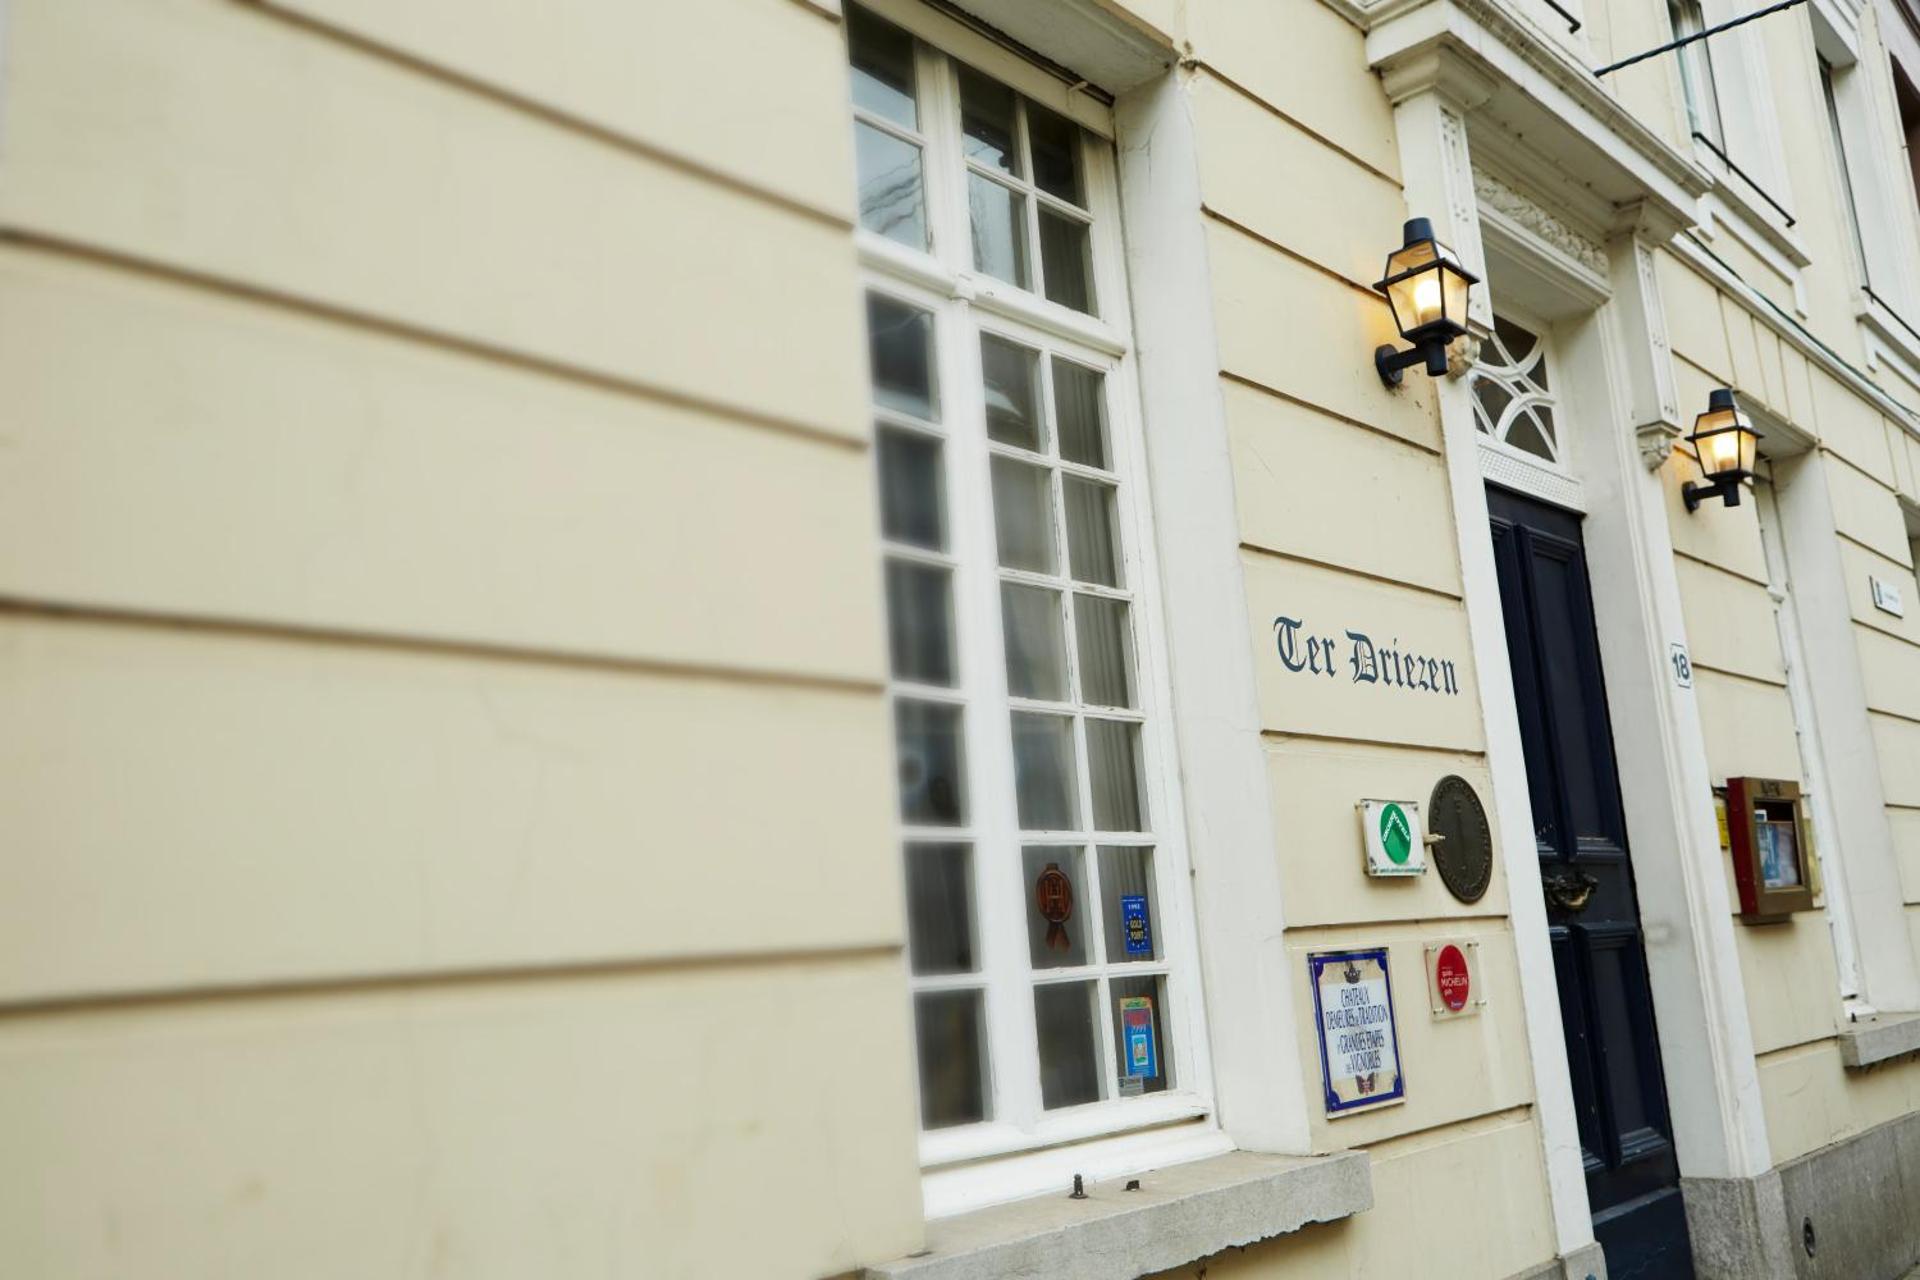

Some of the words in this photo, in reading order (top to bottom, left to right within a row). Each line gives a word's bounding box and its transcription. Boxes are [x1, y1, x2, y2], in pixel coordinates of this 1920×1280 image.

[1273, 616, 1336, 677] Ter
[1345, 629, 1459, 696] Driezen
[1671, 652, 1690, 680] 18
[1441, 977, 1467, 987] MICHELIN
